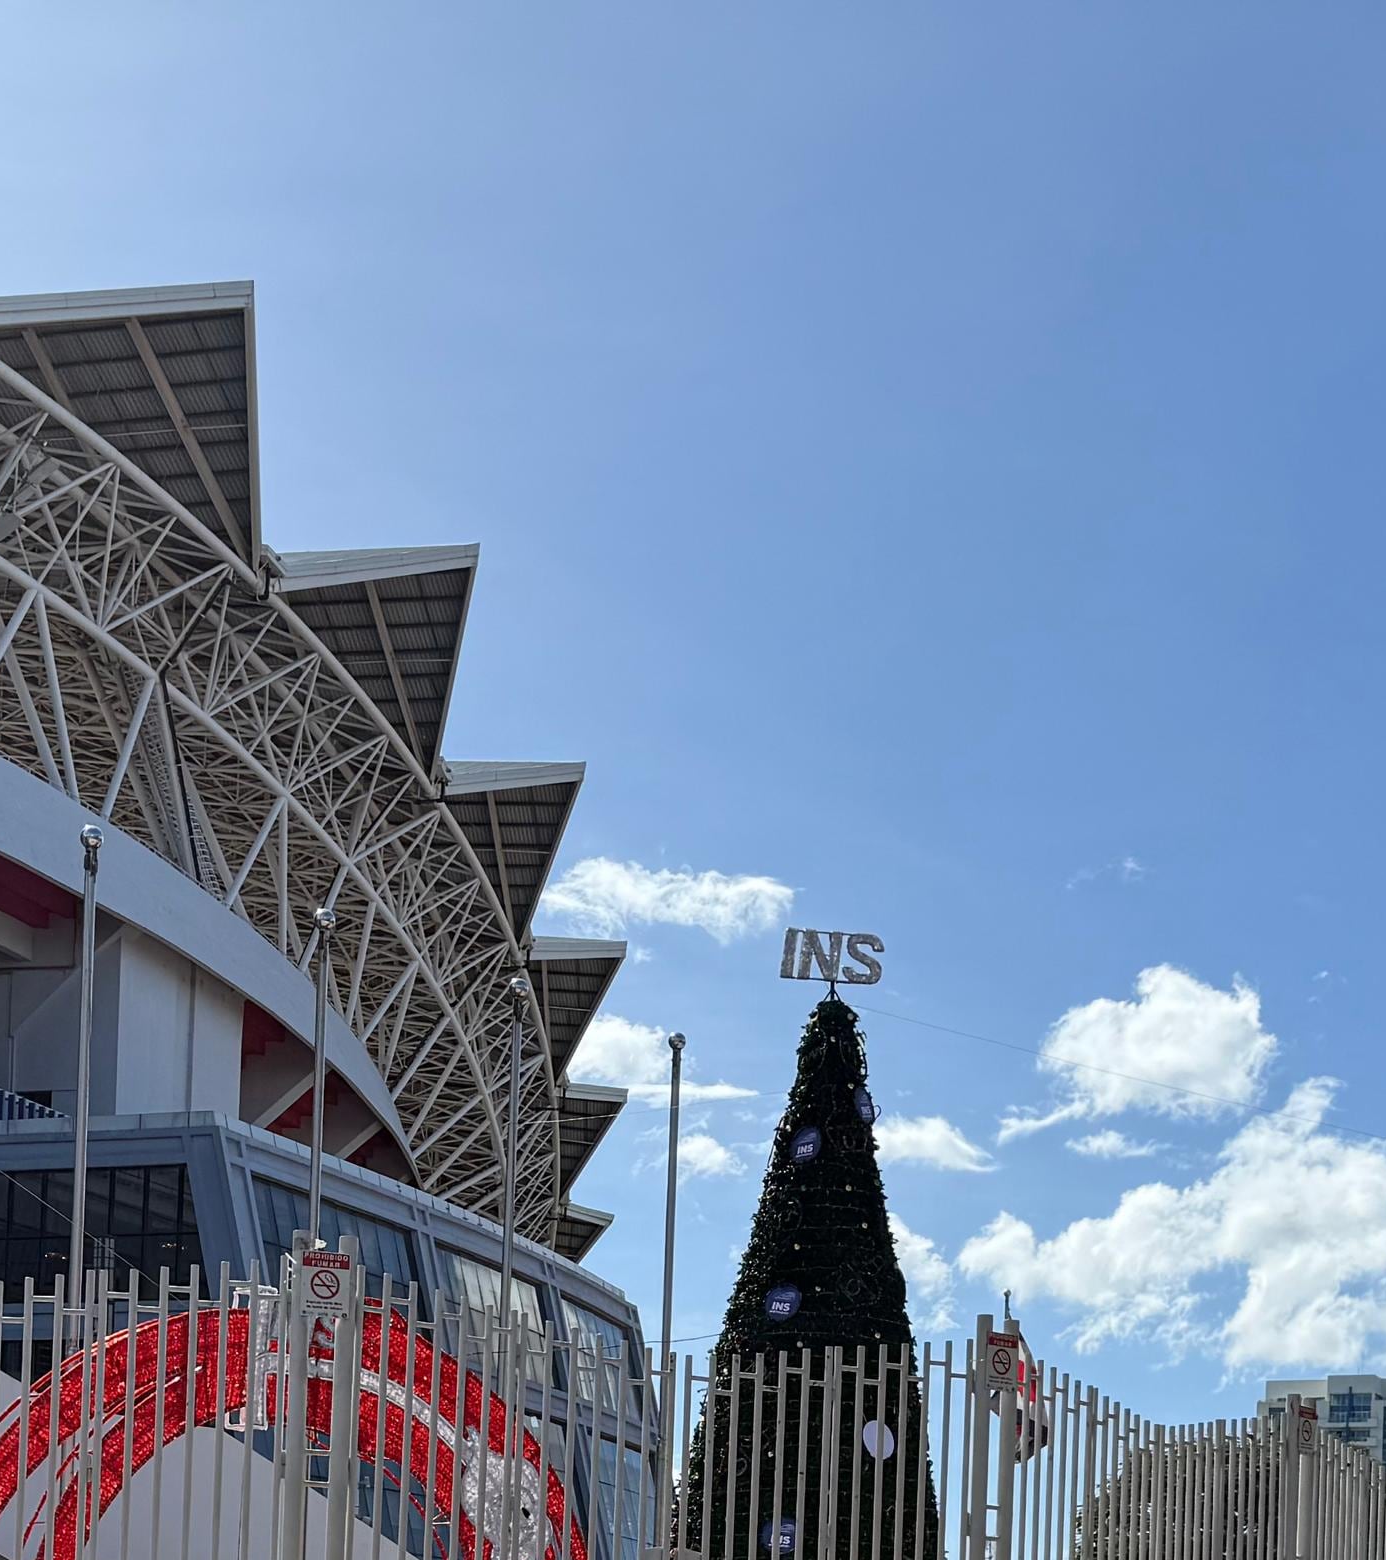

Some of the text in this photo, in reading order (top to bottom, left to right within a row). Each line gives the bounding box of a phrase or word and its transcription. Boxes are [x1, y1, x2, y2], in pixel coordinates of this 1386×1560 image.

[780, 927, 885, 984] INS
[797, 1143, 814, 1155] INS
[304, 1252, 349, 1262] PROHIBIDO
[311, 1259, 341, 1268] FUMAR
[771, 1301, 791, 1312] INS
